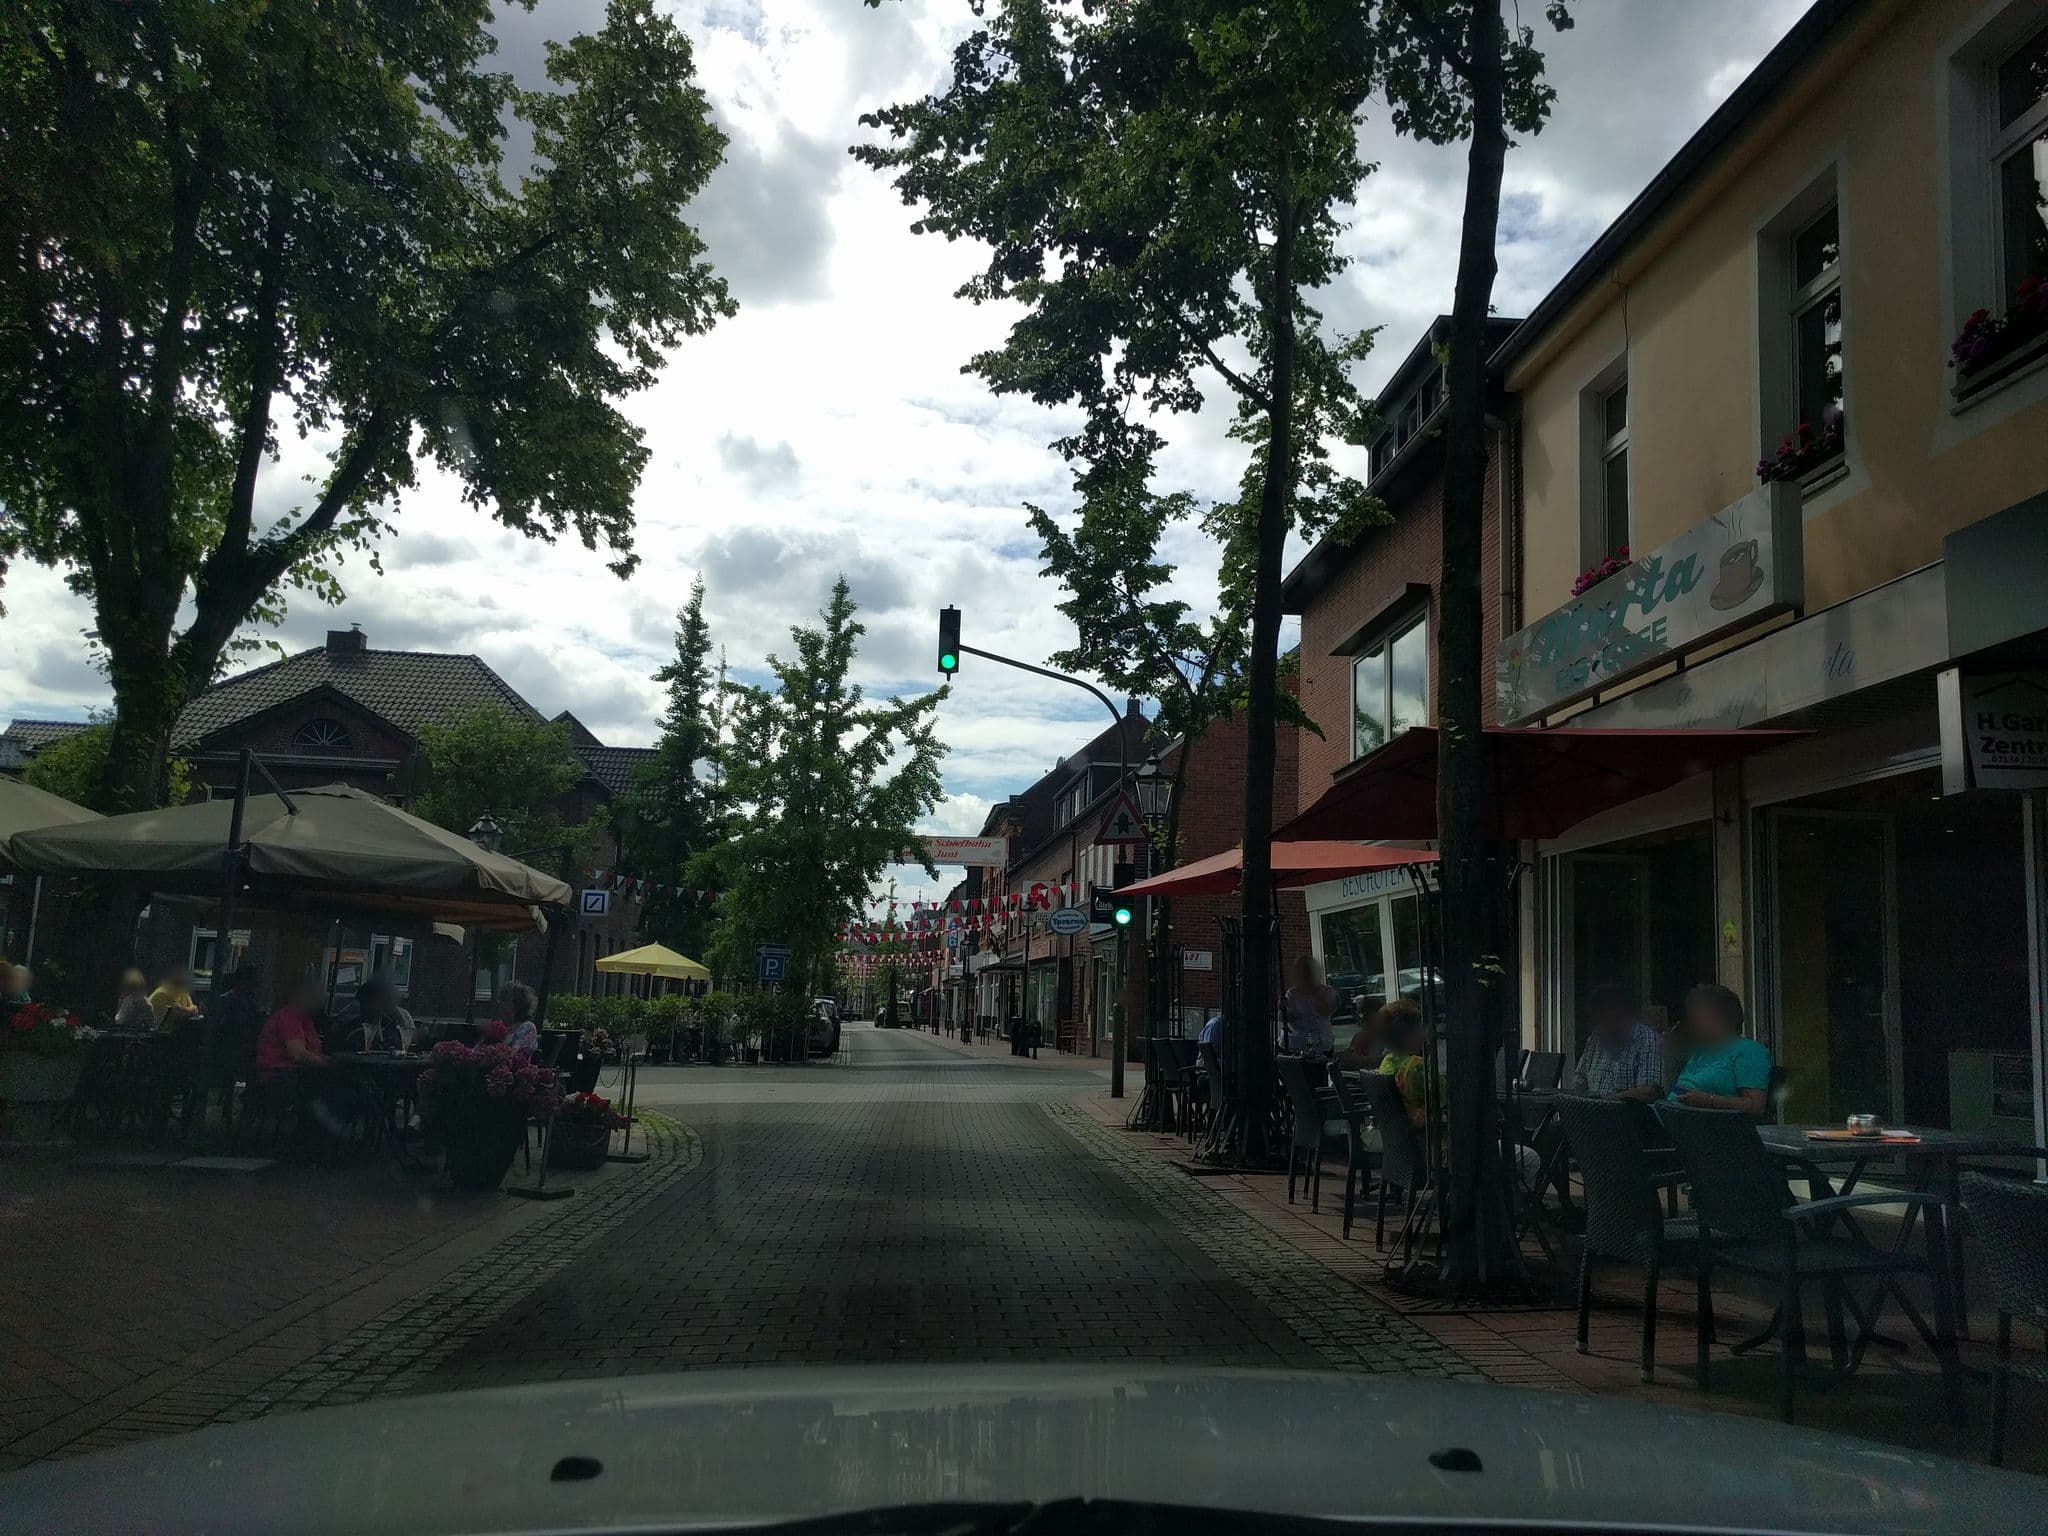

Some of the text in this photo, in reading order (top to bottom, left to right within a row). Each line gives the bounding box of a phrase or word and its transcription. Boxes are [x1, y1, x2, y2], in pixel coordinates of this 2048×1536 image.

[1979, 736, 2048, 755] Zentr
[934, 839, 993, 850] Schiefbahn
[934, 849, 960, 859] Juni
[765, 958, 779, 976] P
